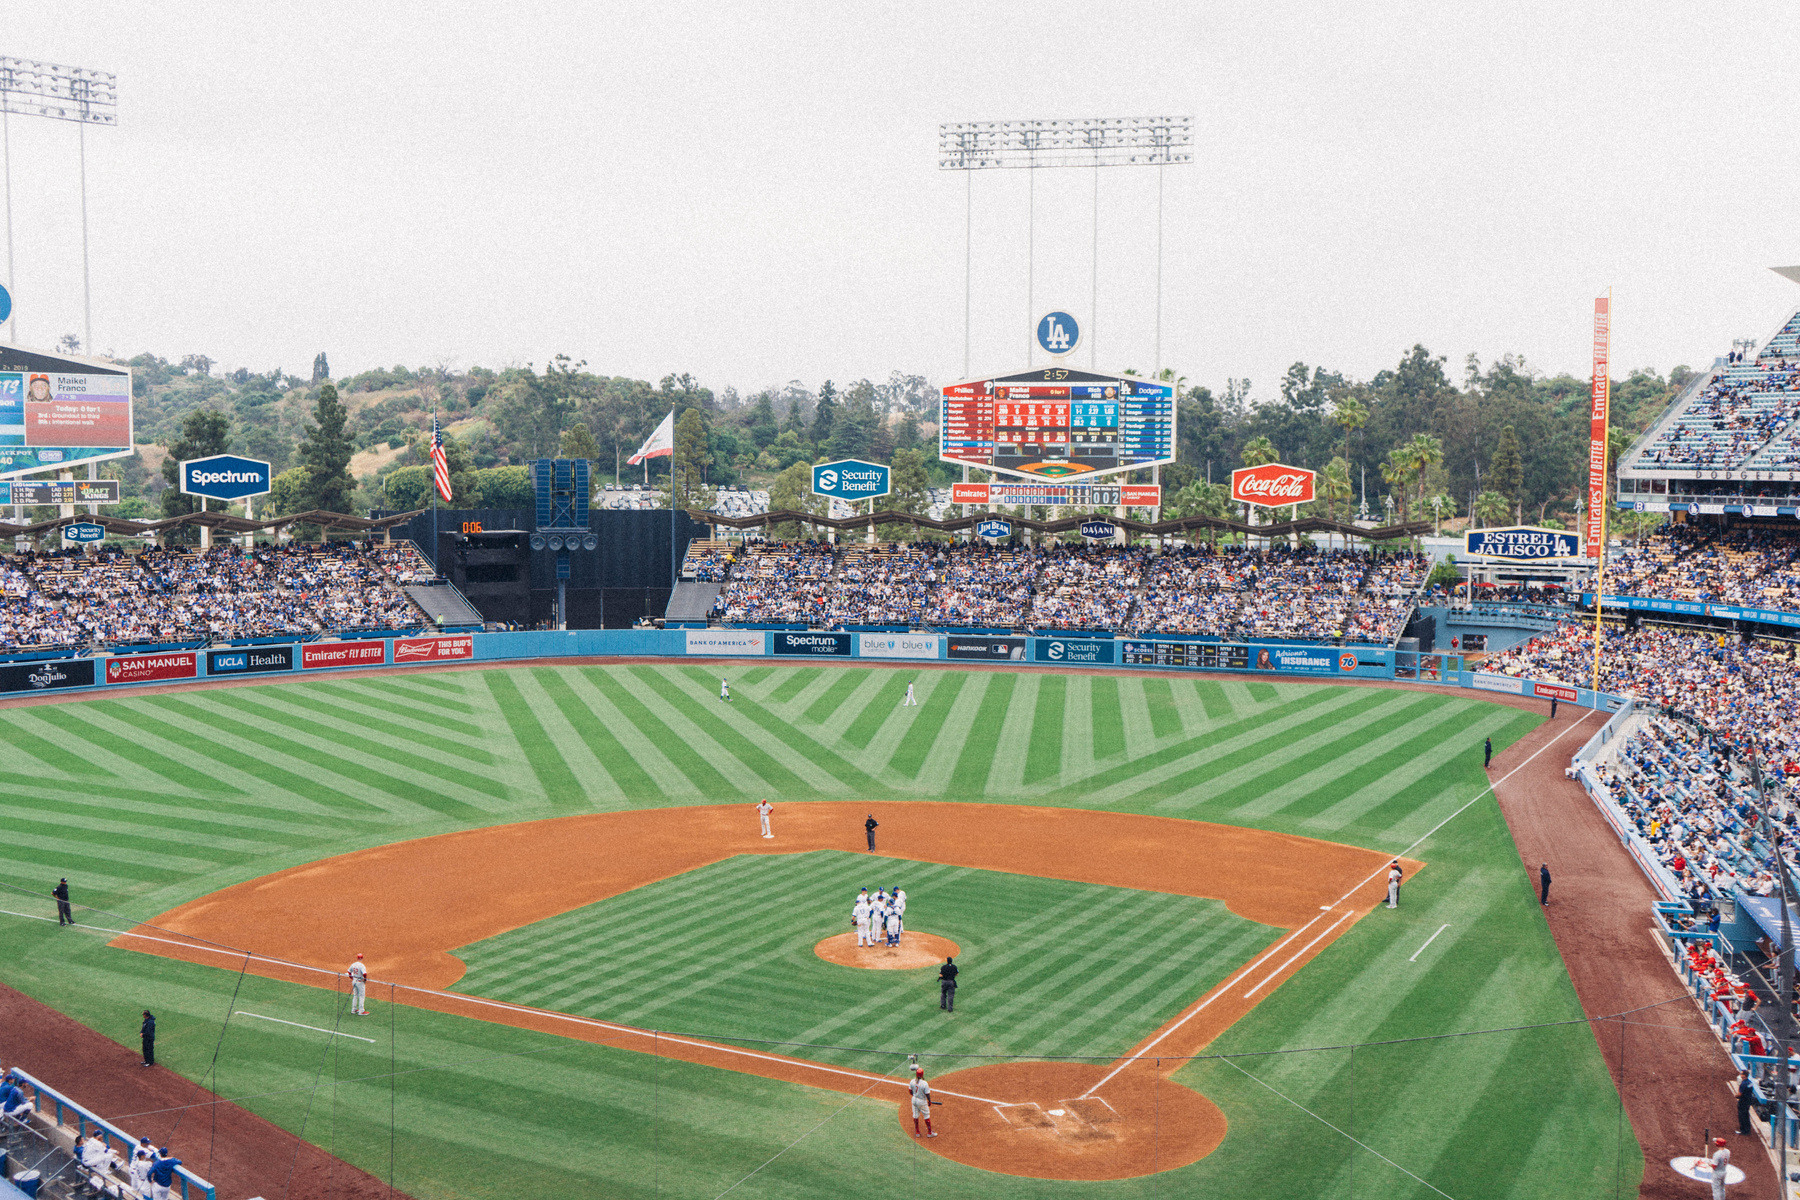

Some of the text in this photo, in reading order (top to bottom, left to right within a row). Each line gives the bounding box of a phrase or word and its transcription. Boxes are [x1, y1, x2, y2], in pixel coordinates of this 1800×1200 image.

[1046, 316, 1070, 349] LA
[1592, 312, 1608, 420] Emirates FLY BETTER
[1044, 370, 1069, 380] 2:57
[192, 470, 259, 486] Spectrum
[842, 470, 883, 482] Security
[1696, 472, 1774, 480] DODGER
[842, 480, 877, 491] Benefit
[1238, 474, 1308, 497] Coca-Cola
[956, 490, 987, 498] Emirates
[1093, 492, 1119, 504] 0 0 2
[1588, 440, 1604, 546] Emirates FLY BETTER
[463, 522, 482, 534] 0:06
[979, 522, 1009, 534] JIM BEAM
[1083, 526, 1113, 534] DASANI
[1475, 544, 1549, 556] JALISCO
[1567, 594, 1579, 602] 2:57
[786, 635, 835, 647] Spectrum
[864, 640, 885, 649] blue
[902, 641, 923, 649] blue
[438, 648, 450, 656] FOR
[1067, 642, 1101, 653] Security
[305, 648, 382, 661] Emirates FLY BETTER
[1068, 652, 1096, 661] Benefit
[1275, 650, 1308, 658] Adriana's
[122, 657, 193, 670] SAN MANUEL
[219, 654, 286, 667] UCLA Health
[1281, 657, 1330, 667] INSURANCE
[1341, 657, 1354, 667] 76
[29, 672, 67, 685] Don Julio
[1537, 686, 1558, 696] Emirates
